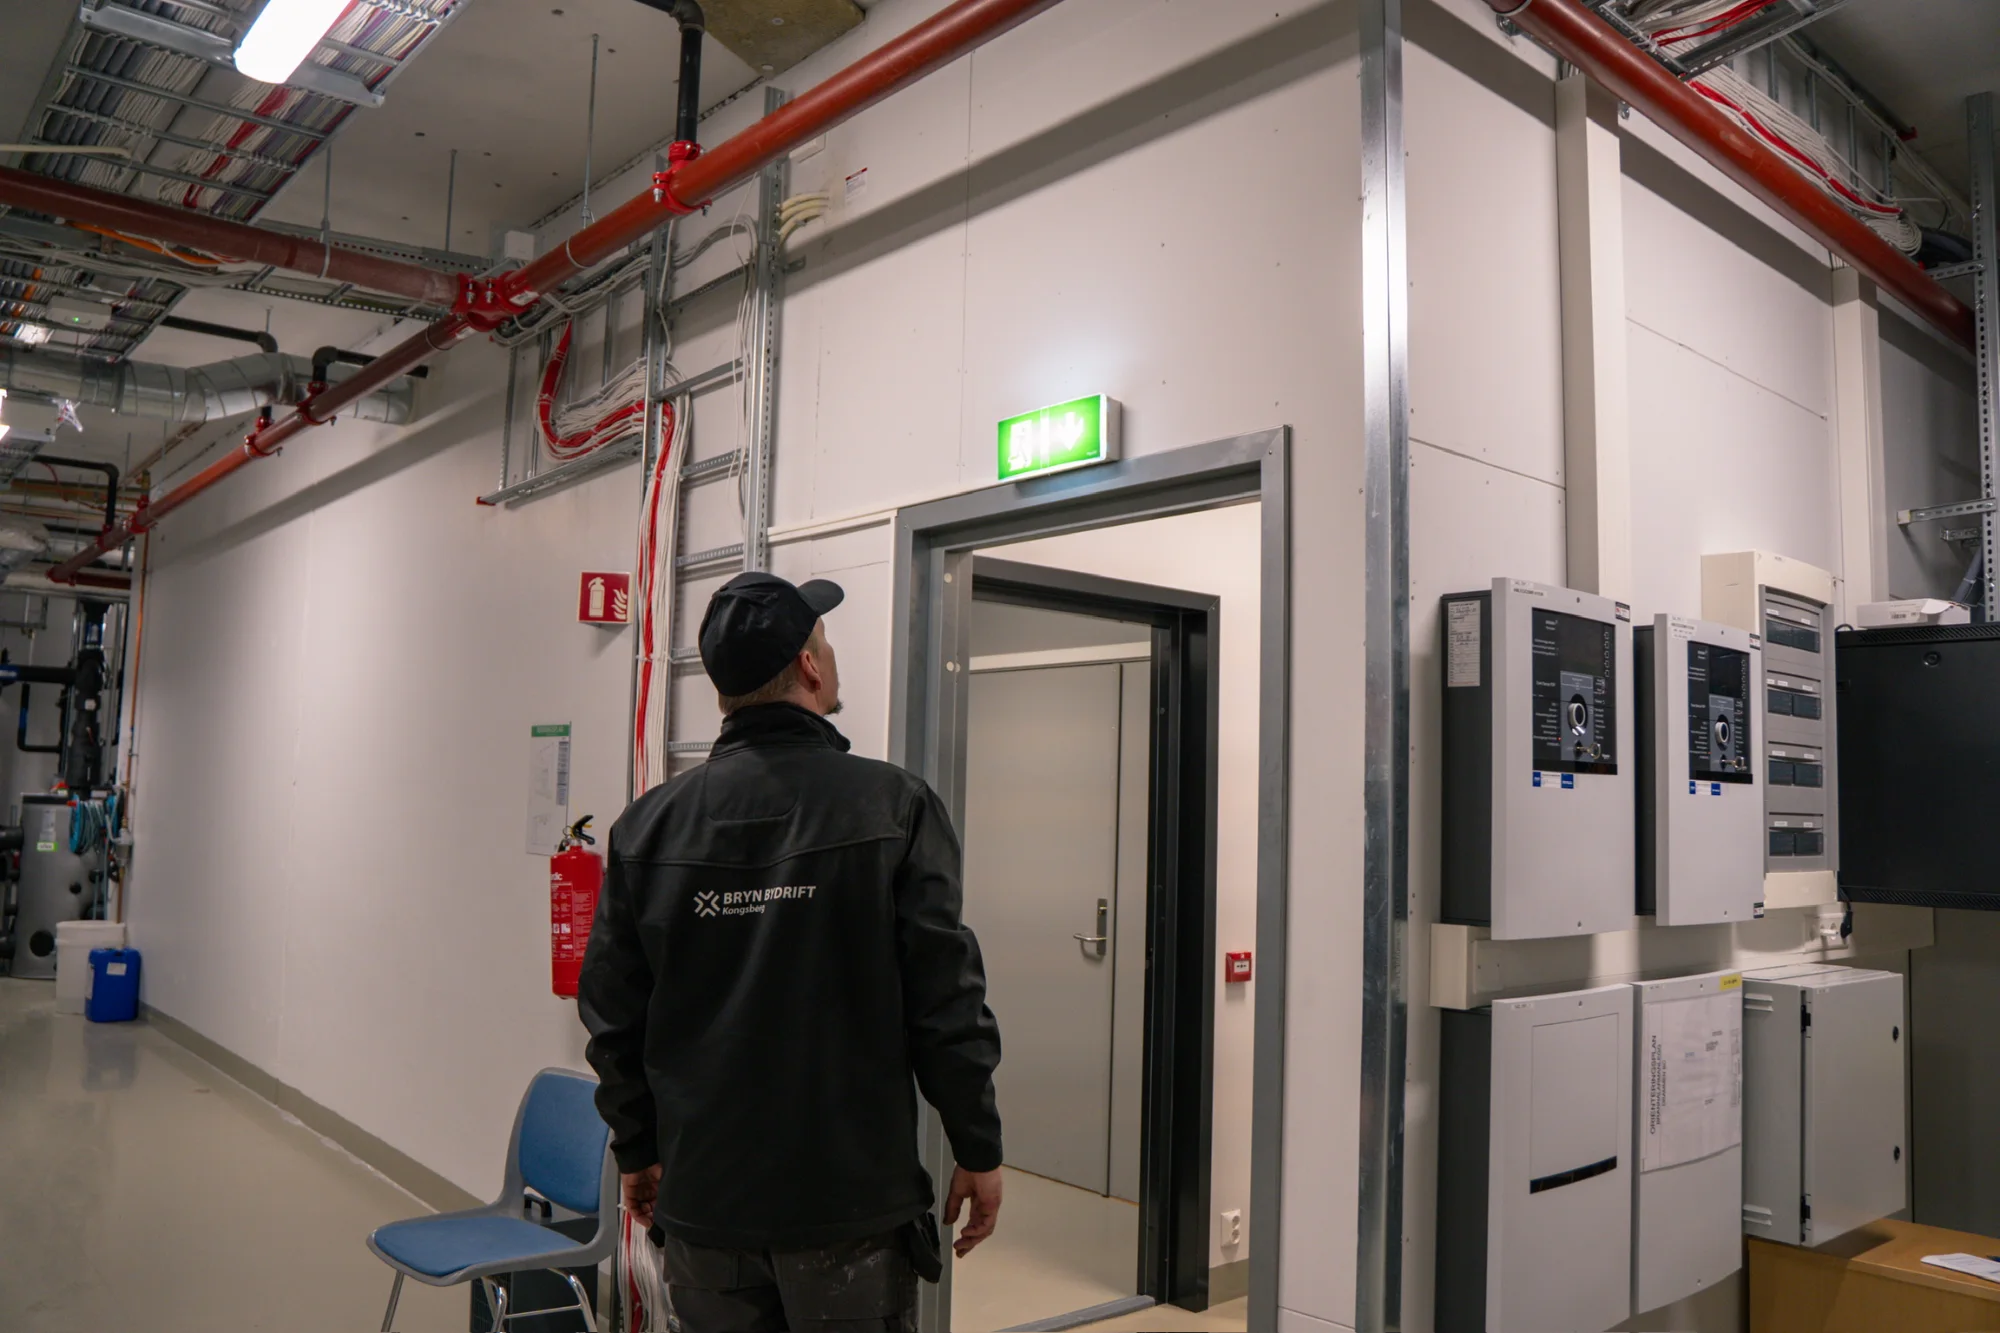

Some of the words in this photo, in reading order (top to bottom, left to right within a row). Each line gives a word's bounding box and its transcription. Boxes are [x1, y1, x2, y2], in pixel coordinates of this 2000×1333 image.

[723, 889, 763, 905] BRYN
[764, 885, 817, 901] BYDRIFT
[722, 904, 766, 916] Kongsberg
[1649, 1035, 1657, 1135] ORIENTERINGSPLAN
